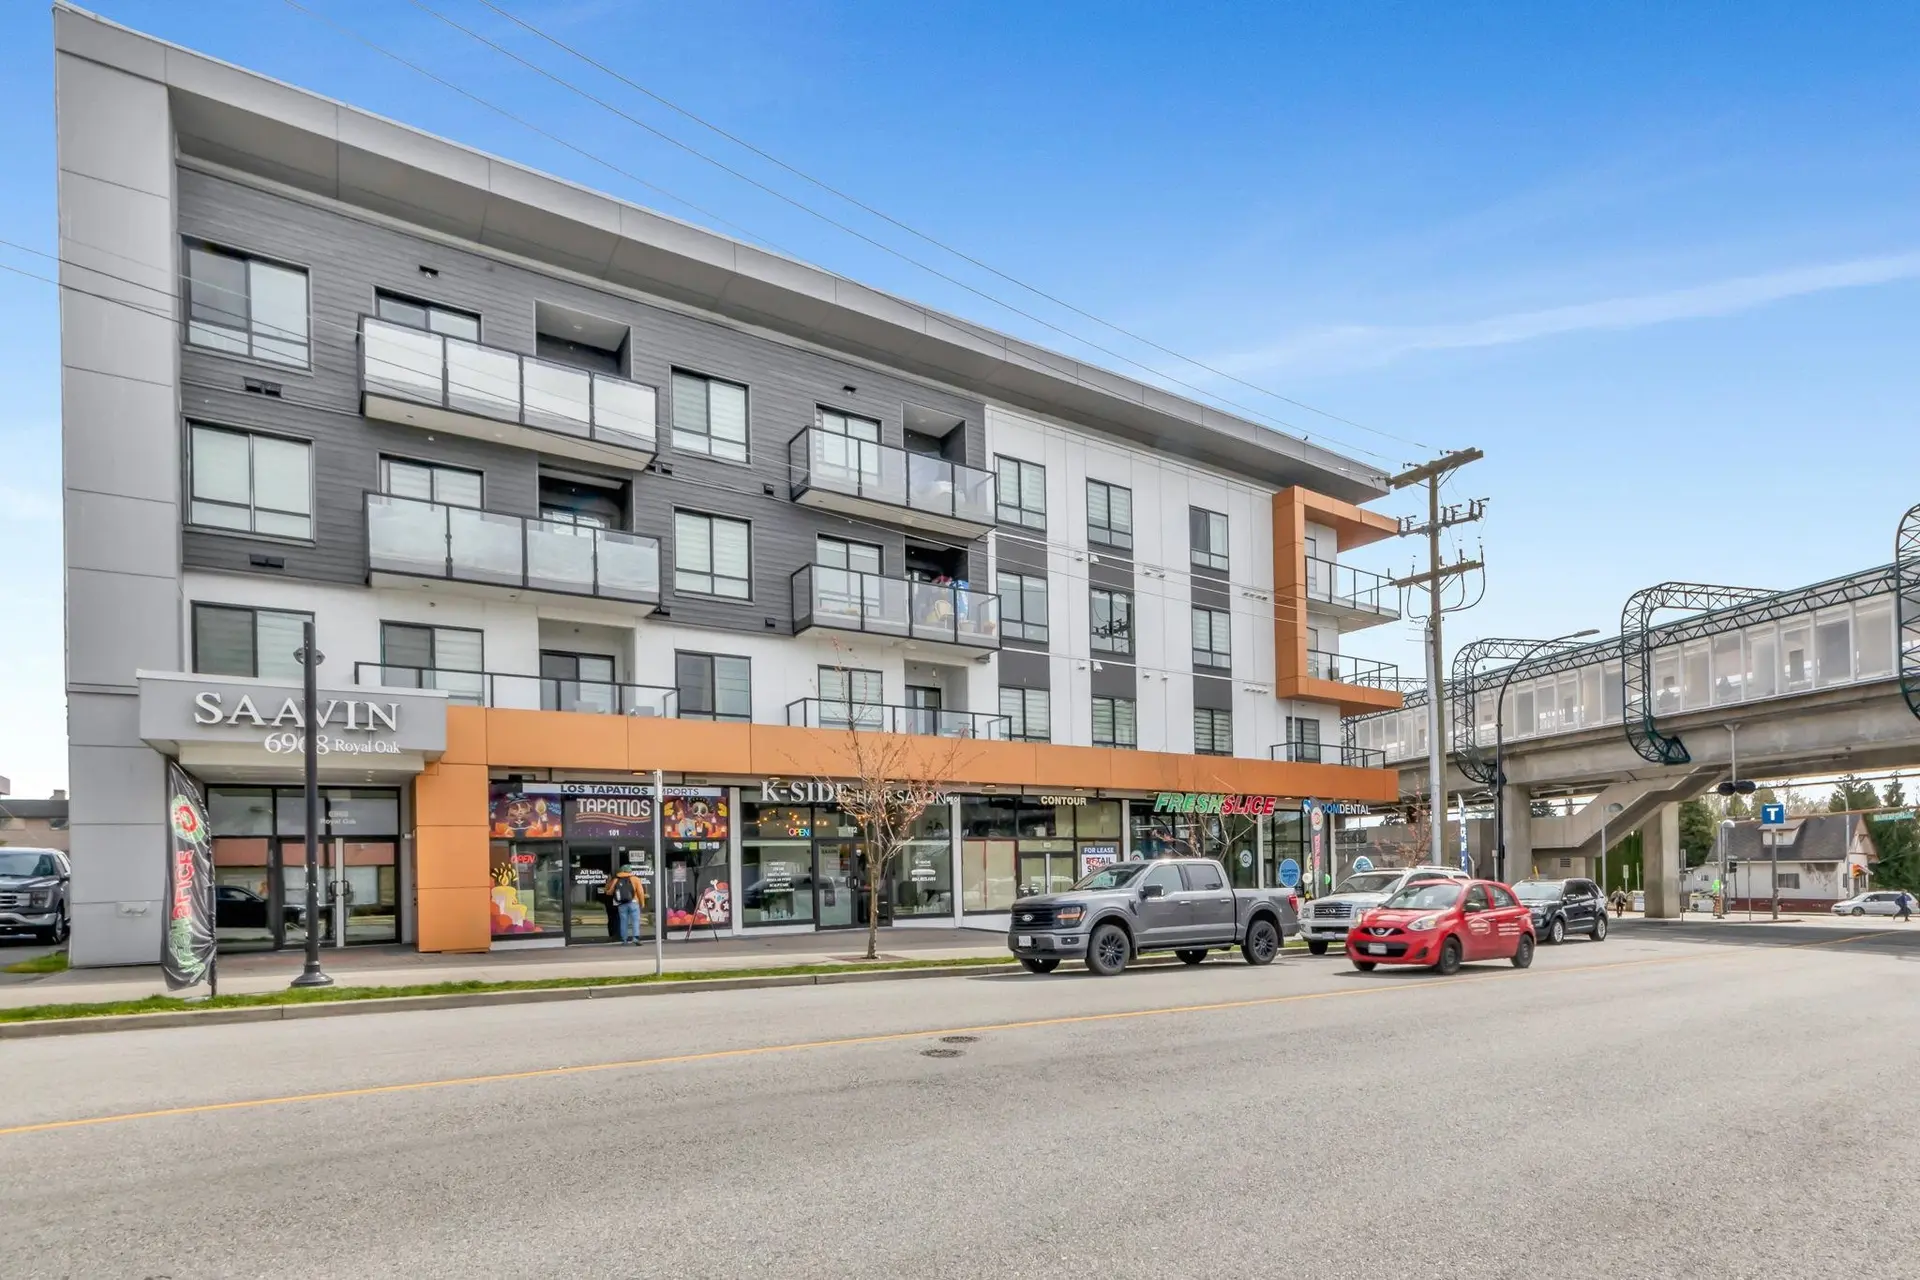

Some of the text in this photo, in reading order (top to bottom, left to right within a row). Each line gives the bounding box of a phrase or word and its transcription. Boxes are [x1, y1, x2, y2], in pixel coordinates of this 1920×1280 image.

[194, 692, 400, 732] SAAVIN
[335, 739, 372, 755] Royal
[374, 741, 401, 754] Oak
[560, 784, 700, 795] LOS TAPATIOS MPORTS
[760, 780, 850, 803] K-SIDE
[1040, 795, 1087, 806] CONTOUR
[576, 798, 651, 817] TAPATIOS
[1766, 807, 1779, 821] T
[608, 829, 620, 837] 101
[788, 828, 811, 838] OPEN
[511, 854, 536, 864] OPEN
